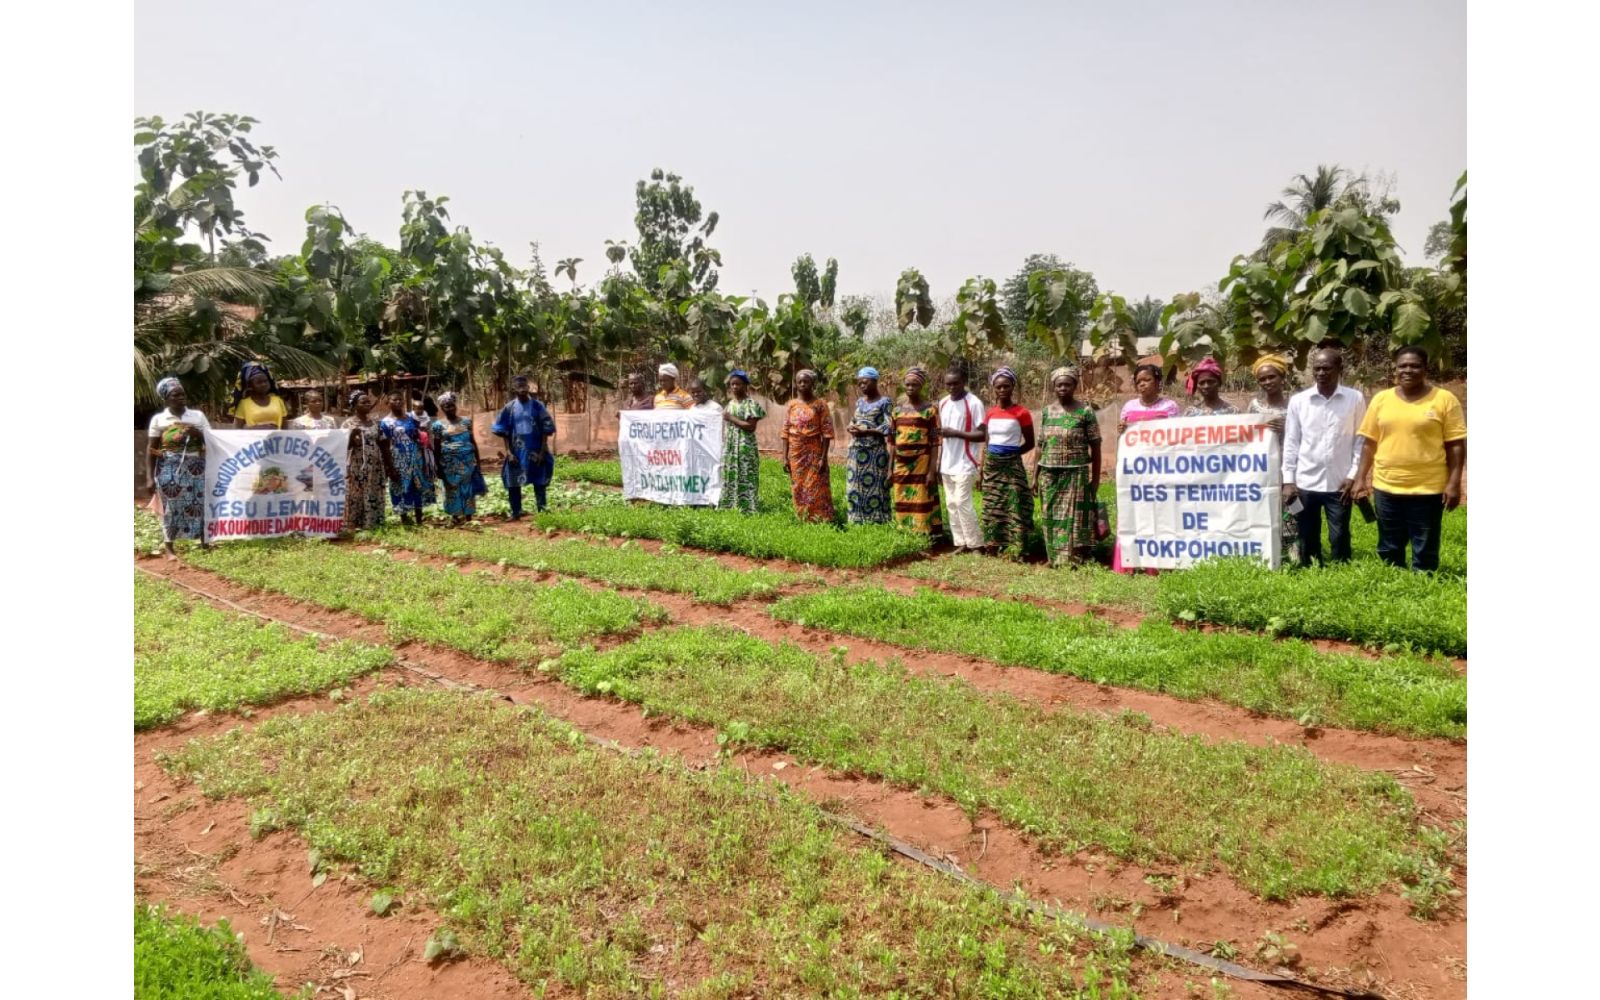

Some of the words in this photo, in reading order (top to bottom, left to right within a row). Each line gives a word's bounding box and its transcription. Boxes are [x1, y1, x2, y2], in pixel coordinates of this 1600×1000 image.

[629, 421, 706, 440] GROUPEMENT
[1125, 424, 1266, 447] GROUPEMENT
[212, 436, 283, 498] GROUPEMENT
[284, 436, 310, 458] DES
[309, 446, 346, 497] FEMMES
[646, 449, 682, 466] AGNON
[1123, 454, 1267, 475] LONLONGNON
[1130, 484, 1168, 502] DES
[1175, 483, 1262, 502] FEMMES
[209, 501, 257, 518] YESU
[267, 500, 320, 517] LEMIN
[326, 501, 345, 517] DE
[1182, 512, 1208, 530] DE
[1134, 539, 1262, 559] TOKPOHOUE
